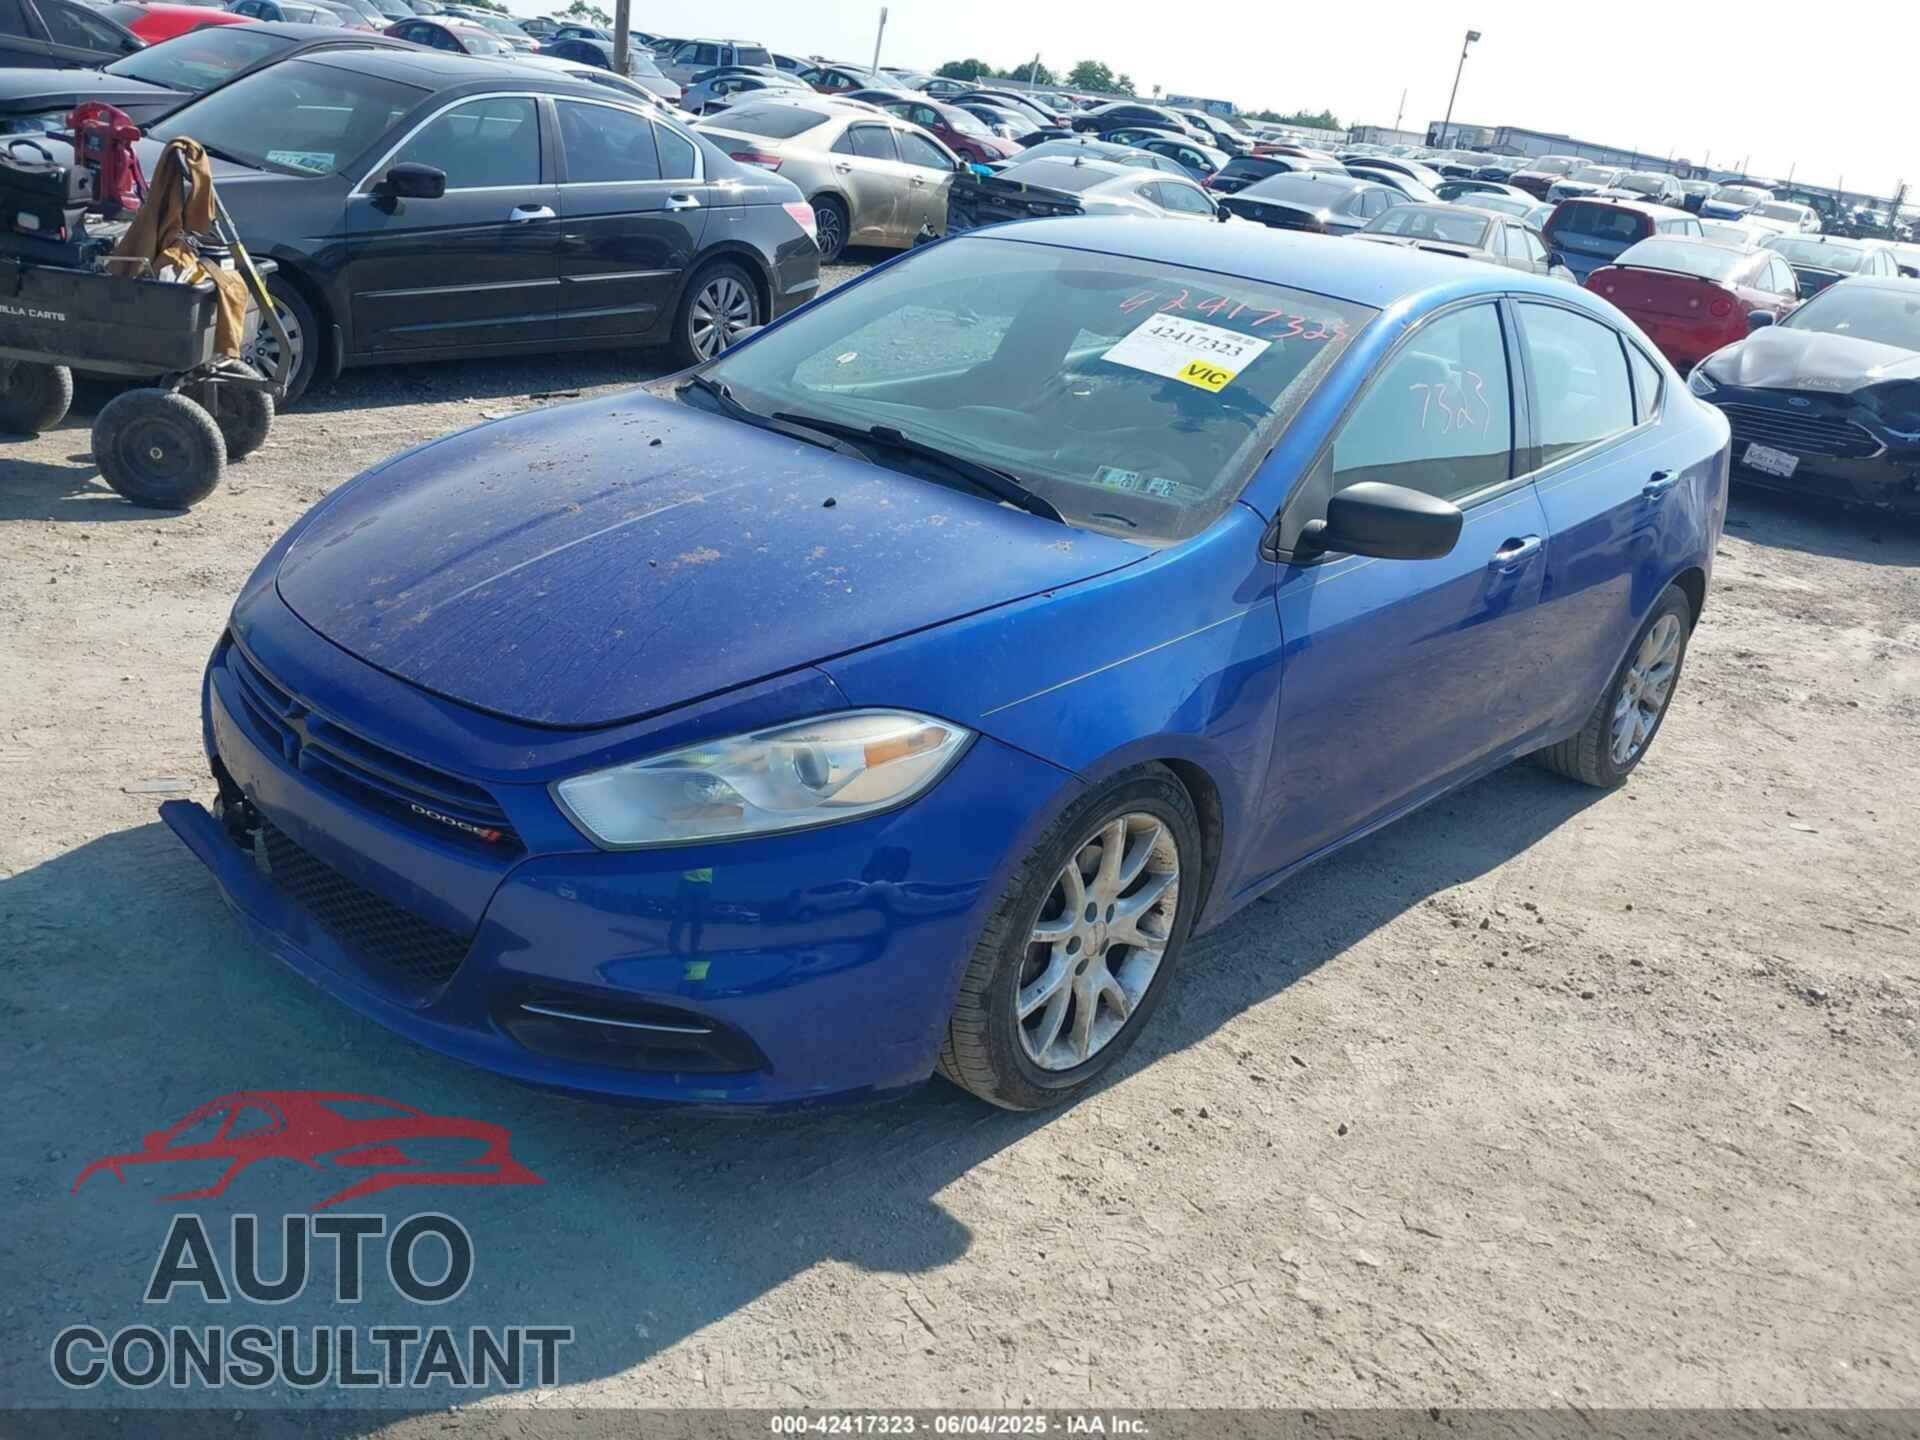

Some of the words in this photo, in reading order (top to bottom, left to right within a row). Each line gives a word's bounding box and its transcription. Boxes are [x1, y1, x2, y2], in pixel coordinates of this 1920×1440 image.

[28, 309, 65, 321] CARTS
[1149, 326, 1244, 357] 42417323
[1188, 364, 1228, 385] VIC
